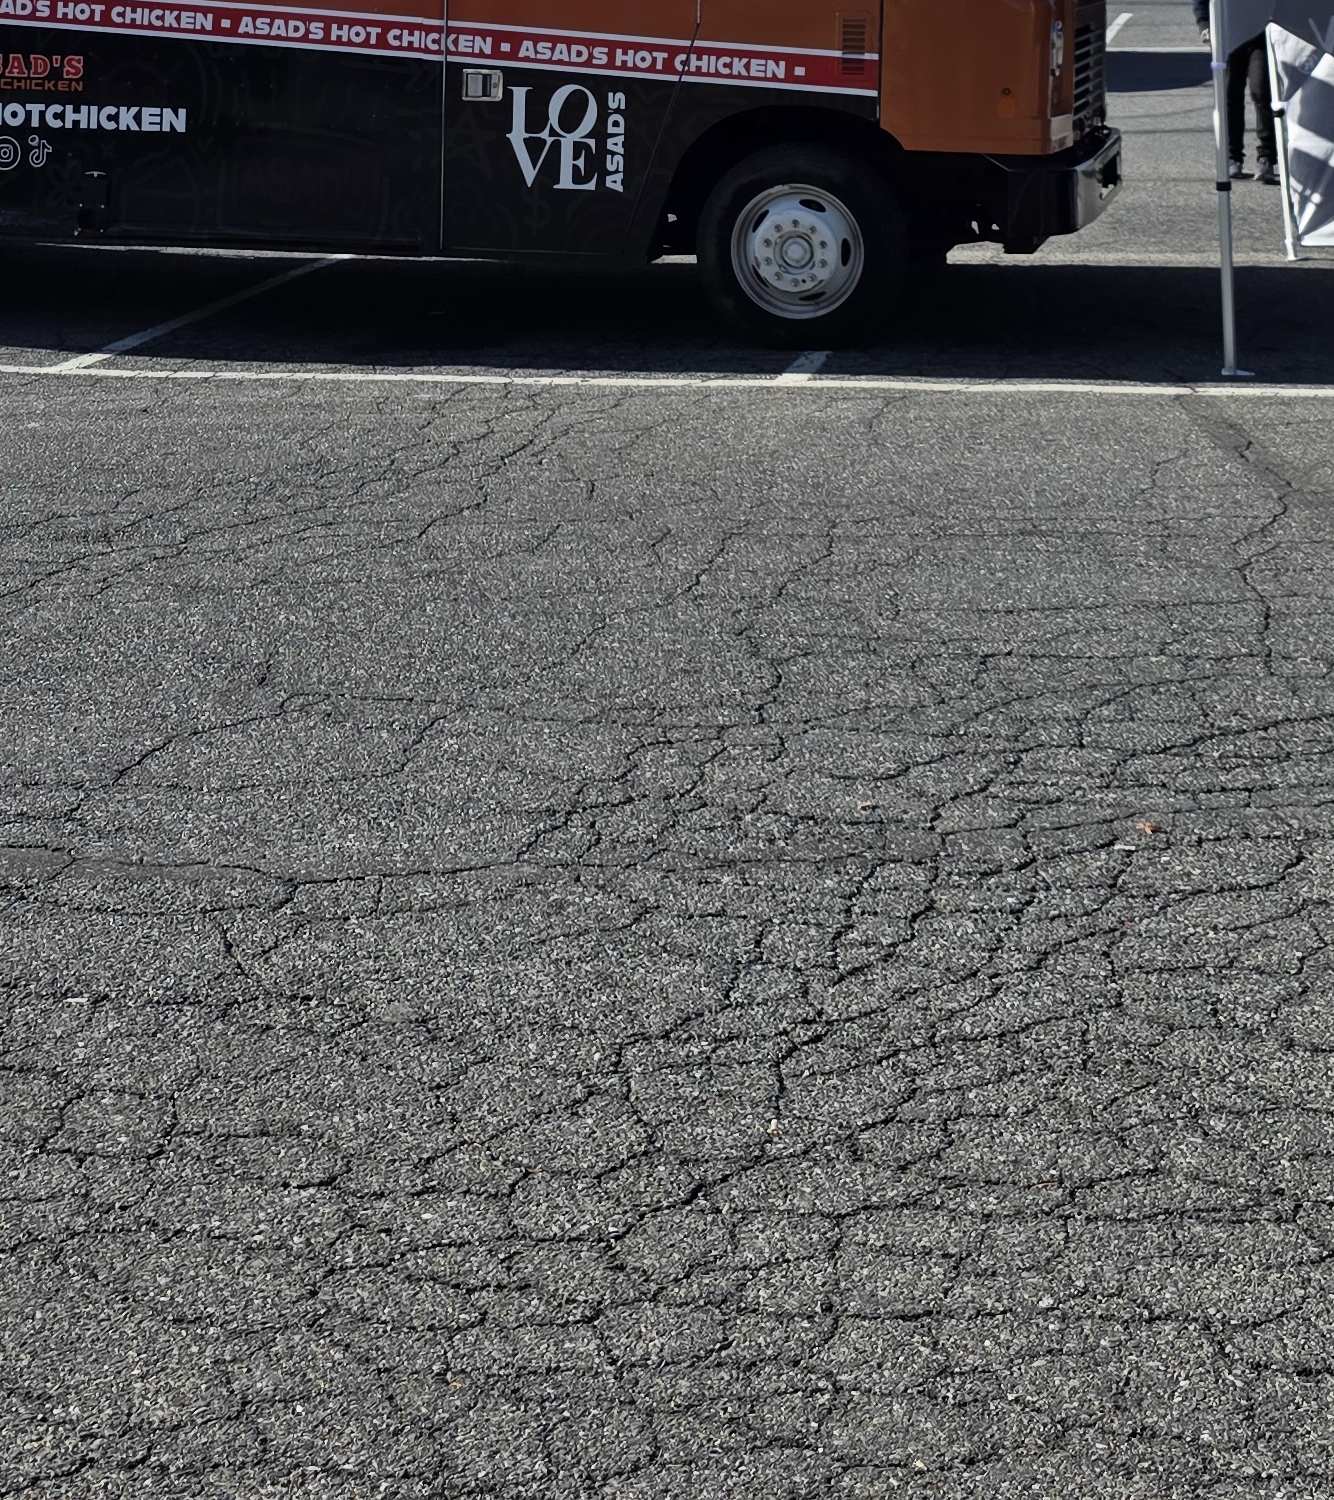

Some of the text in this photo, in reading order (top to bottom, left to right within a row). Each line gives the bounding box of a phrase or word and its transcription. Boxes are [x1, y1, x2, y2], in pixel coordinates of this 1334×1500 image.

[56, 2, 106, 22] HOT
[110, 6, 214, 31] CHICKEN
[237, 16, 325, 40] ASAD'S
[330, 24, 382, 45] HOT
[386, 28, 493, 55] CHICKEN
[517, 40, 609, 65] ASAD'S
[615, 49, 669, 70] HOT
[673, 53, 786, 79] CHICKEN
[0, 79, 84, 92] CHICKEN
[605, 91, 626, 193] ASAD'S
